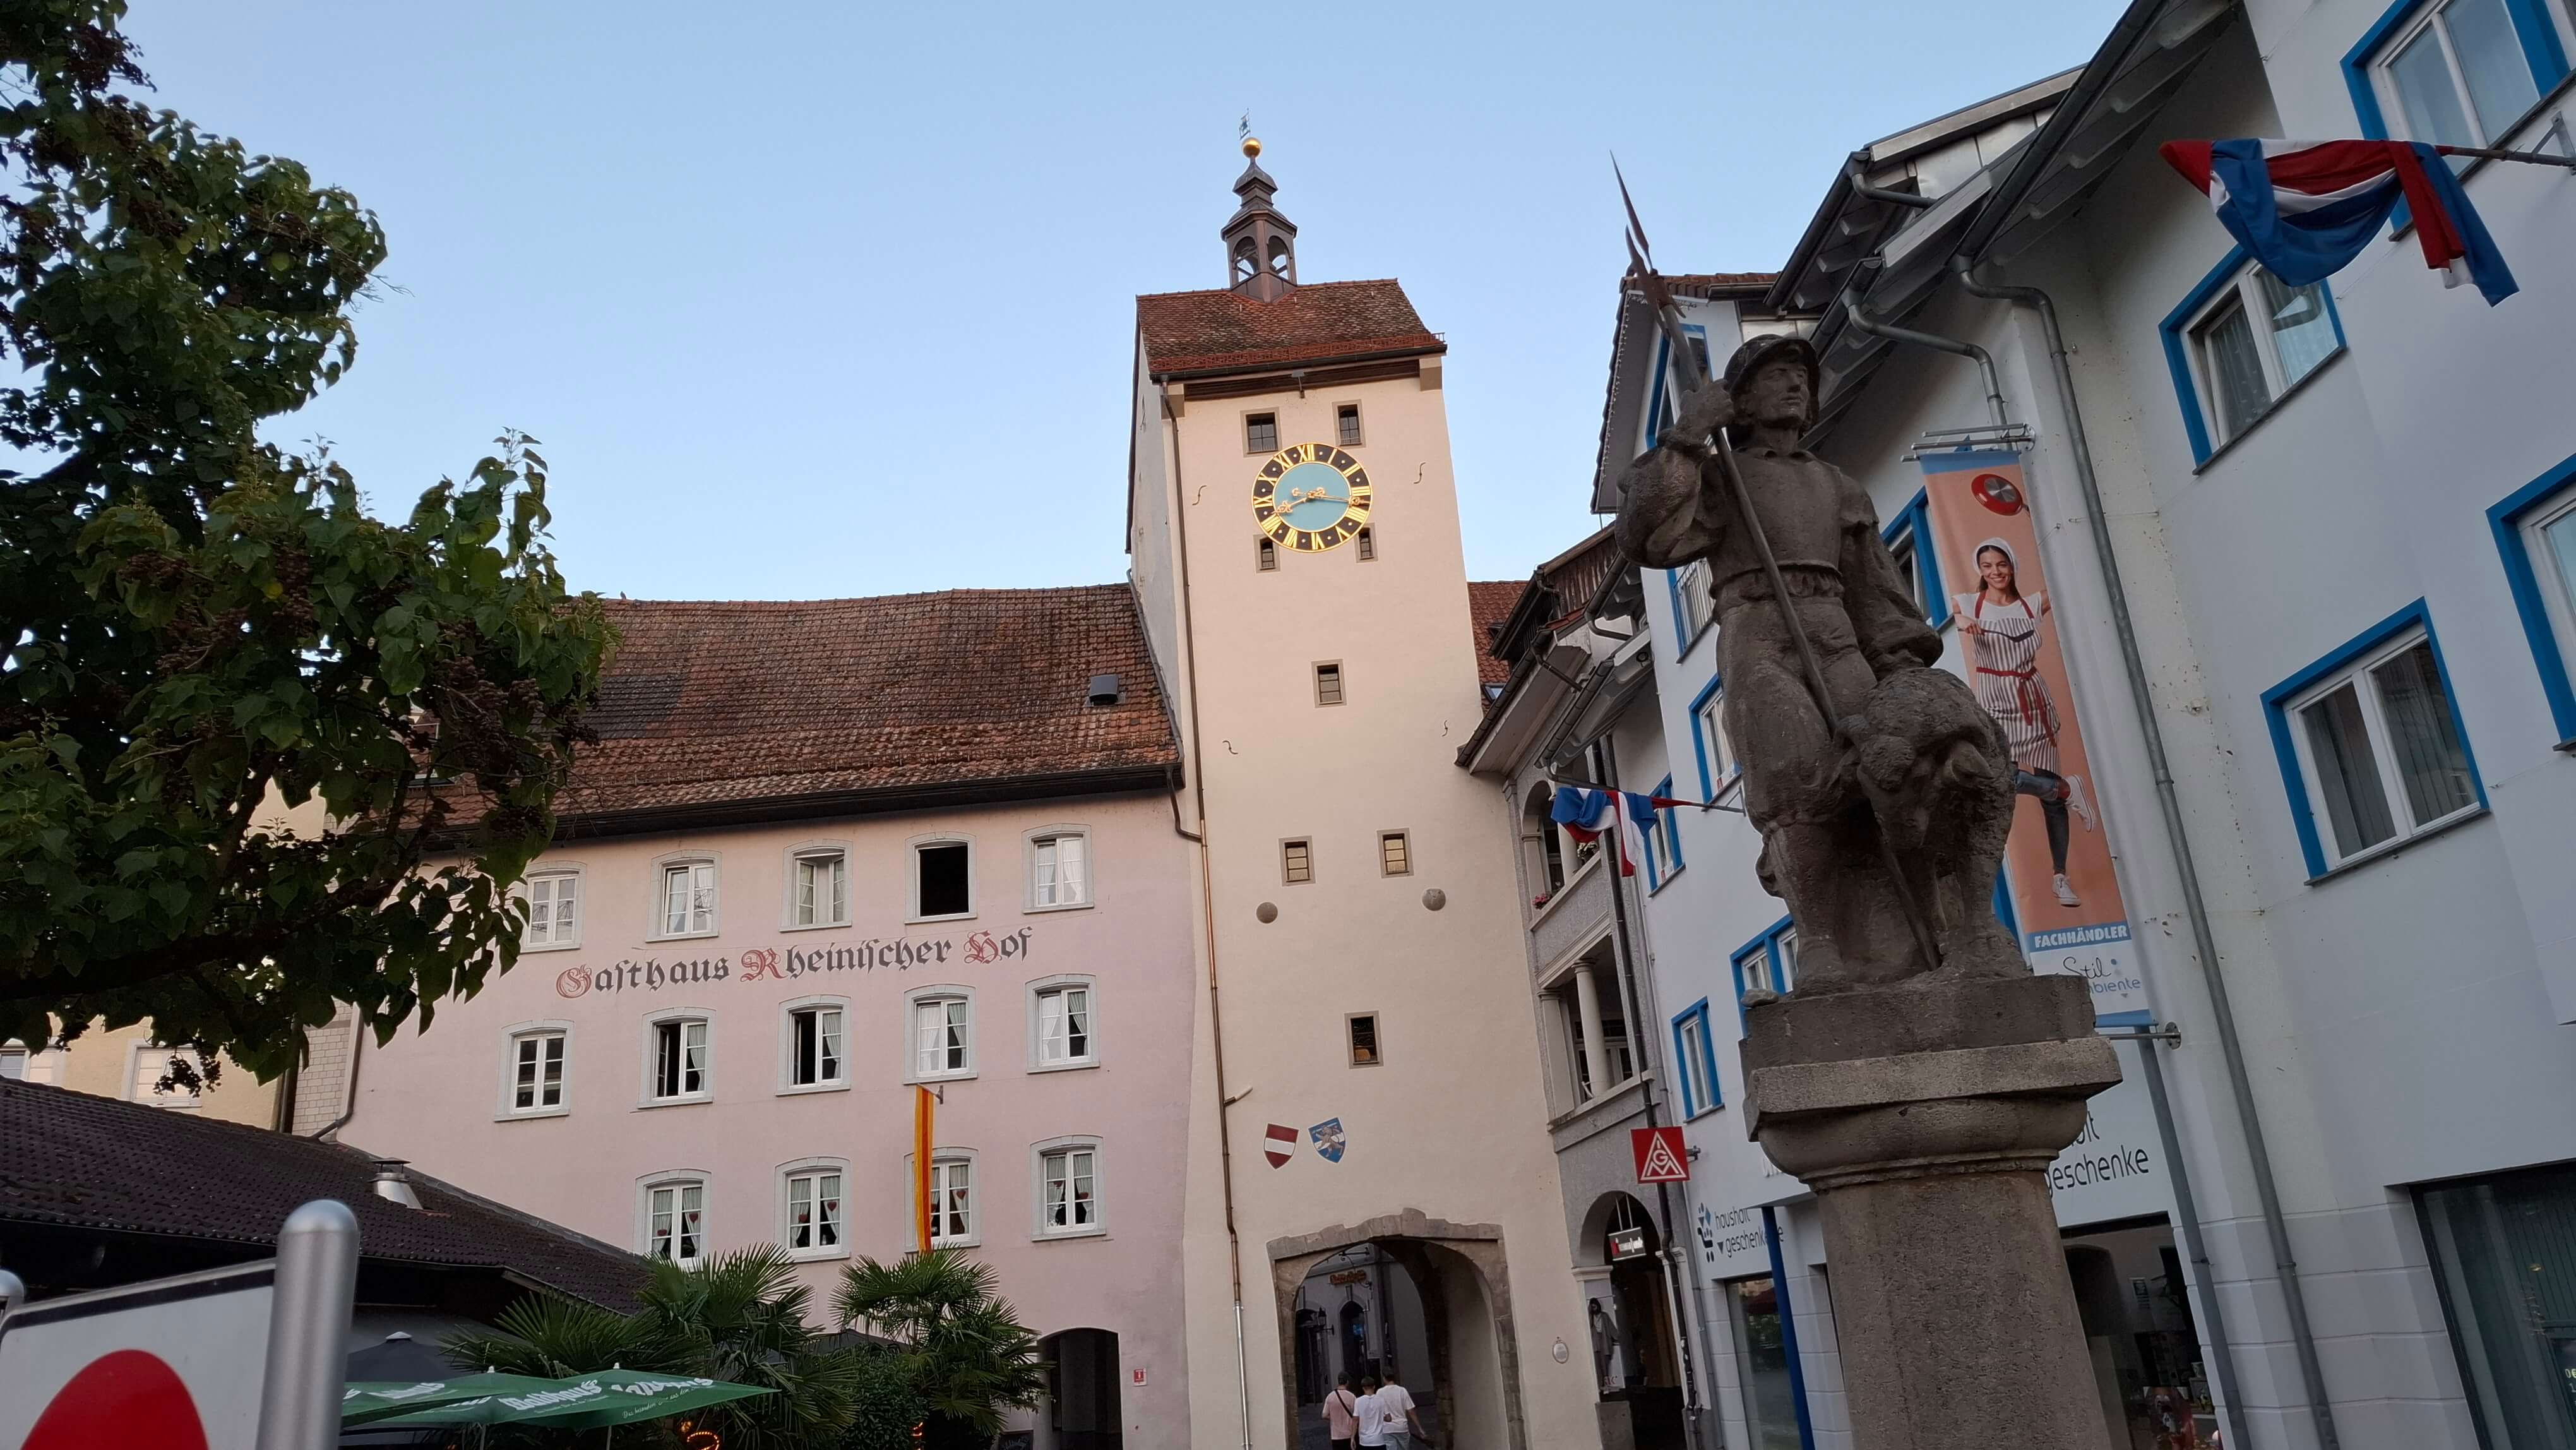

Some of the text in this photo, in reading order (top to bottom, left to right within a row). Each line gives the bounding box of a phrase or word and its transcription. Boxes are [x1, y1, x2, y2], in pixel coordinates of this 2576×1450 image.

[963, 926, 1034, 966] Hof
[2034, 925, 2128, 948] FACHHÄNDLER
[2063, 956, 2111, 979] Stil
